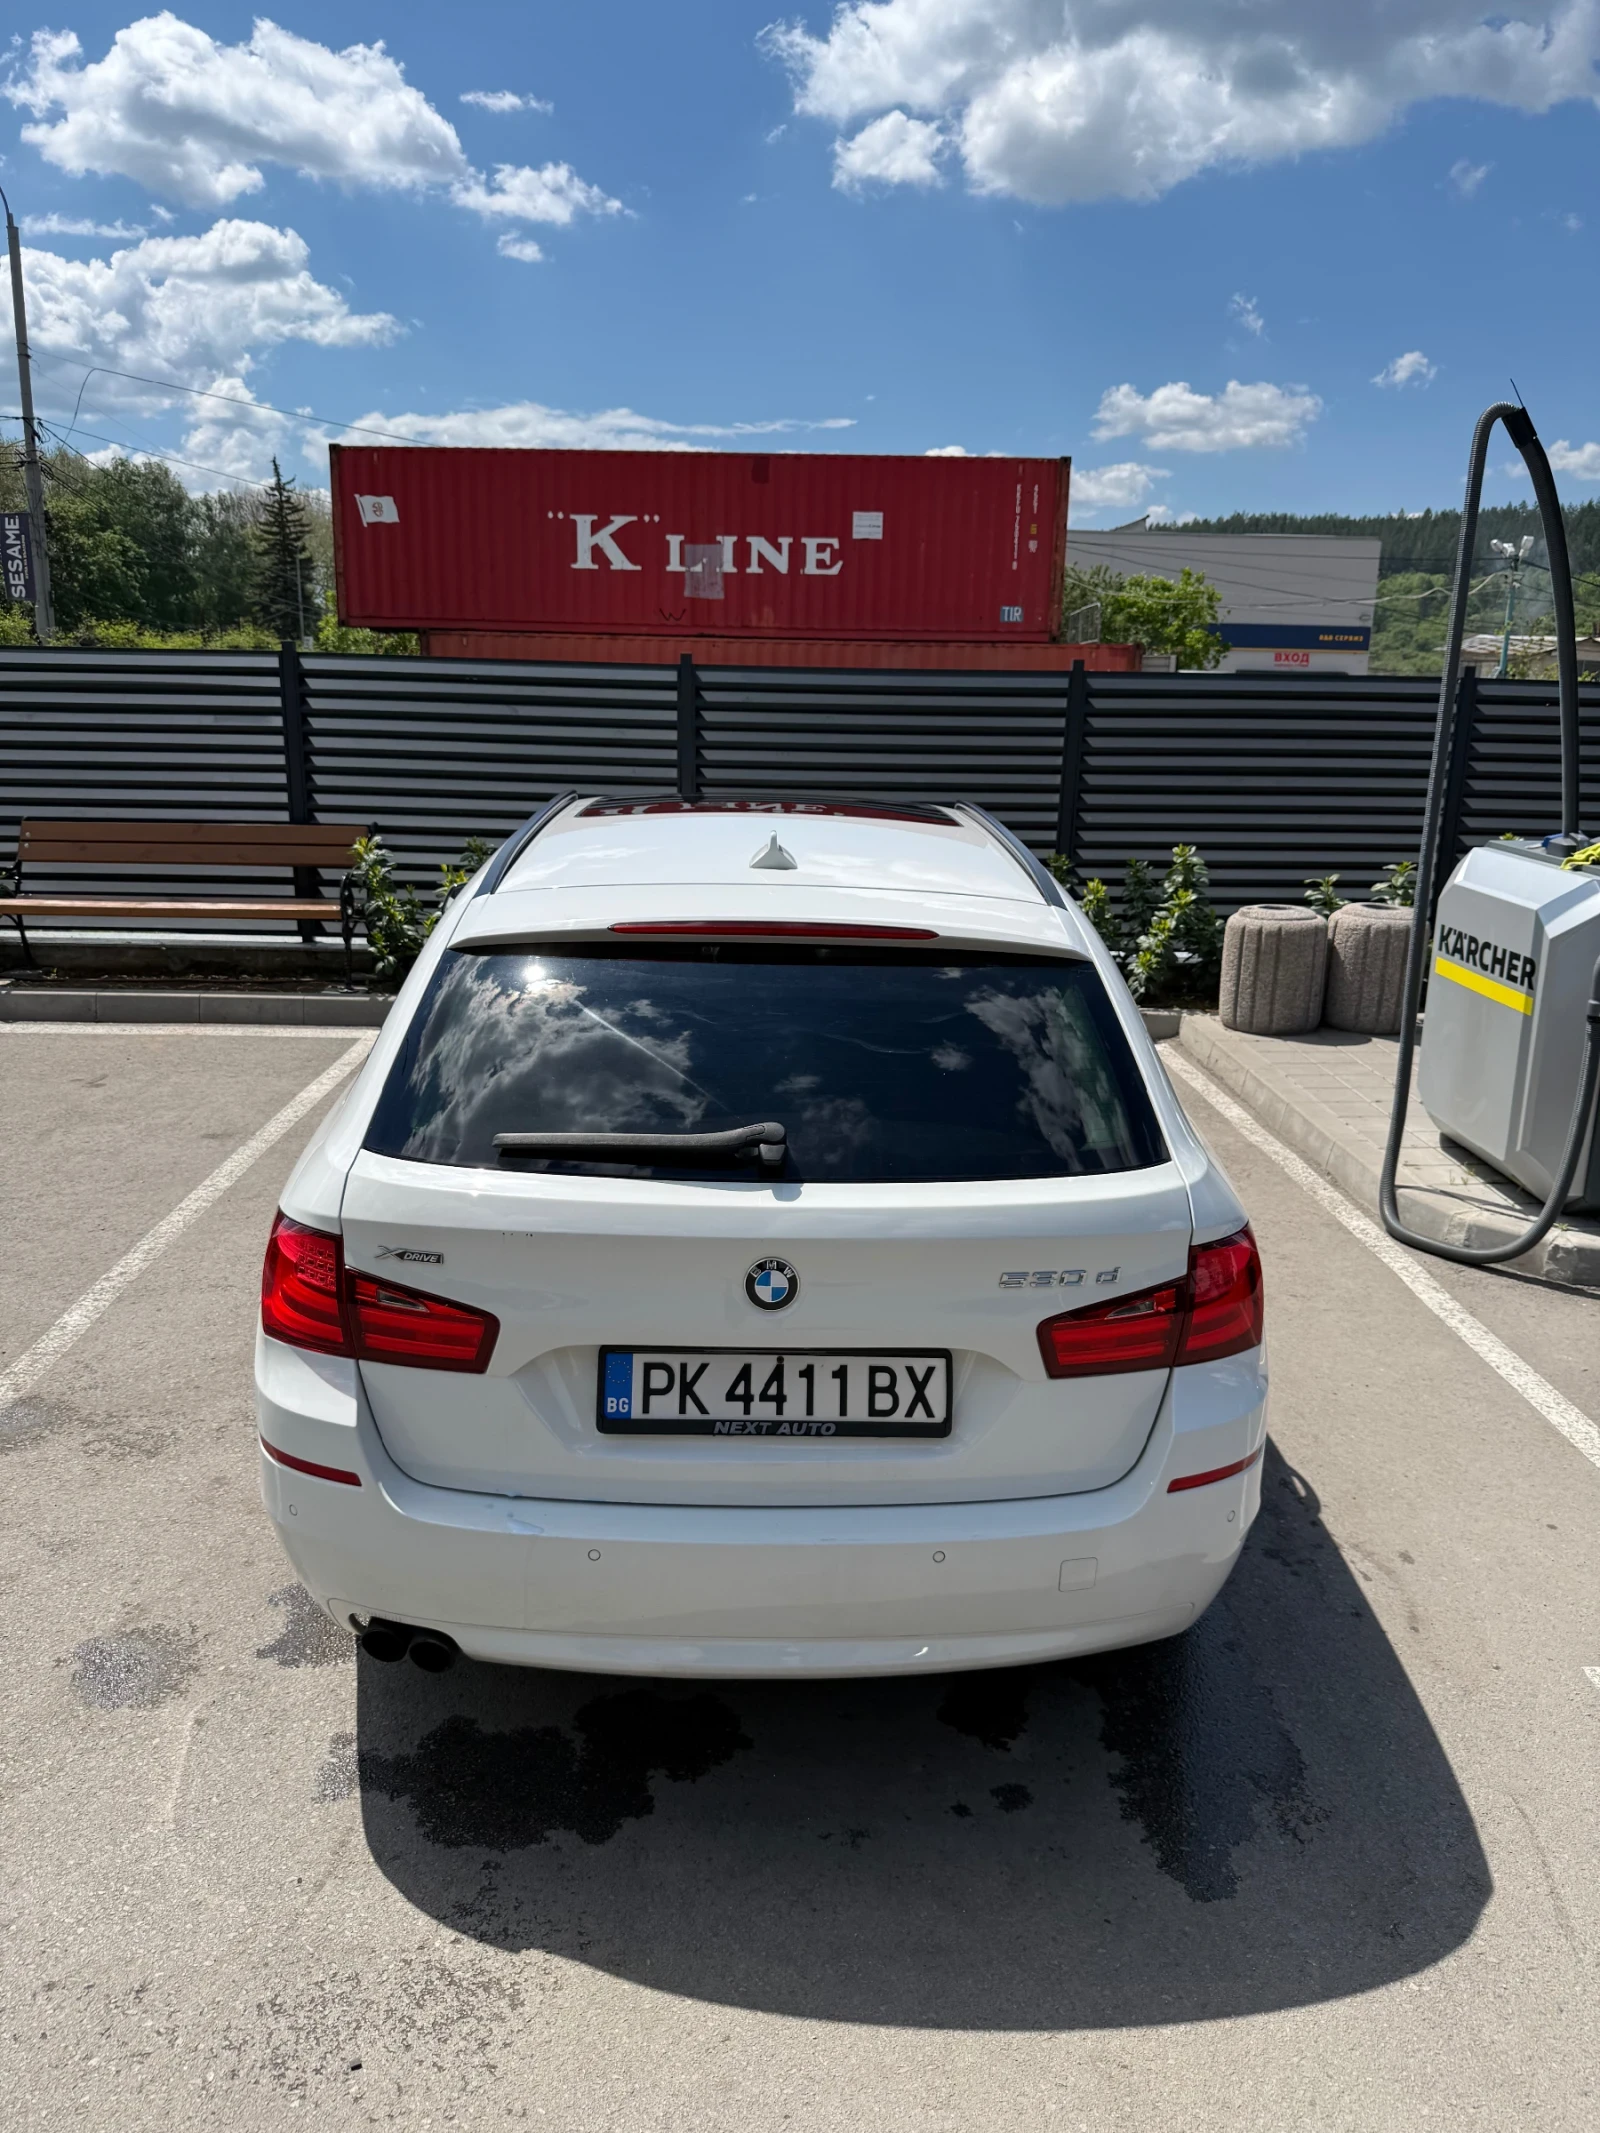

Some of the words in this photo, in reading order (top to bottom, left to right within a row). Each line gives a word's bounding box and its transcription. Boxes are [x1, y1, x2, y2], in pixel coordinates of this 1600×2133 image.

[665, 534, 844, 575] LINE
[1002, 606, 1022, 622] TIR
[1274, 652, 1309, 663] ВХОД
[1437, 923, 1536, 992] KÄRCHER
[749, 1259, 794, 1279] BMW
[641, 1361, 711, 1415] PK
[724, 1362, 848, 1417] 4411
[867, 1364, 938, 1419] BX
[606, 1397, 630, 1413] BG
[713, 1421, 771, 1435] NEXT
[775, 1421, 837, 1437] AUTO
